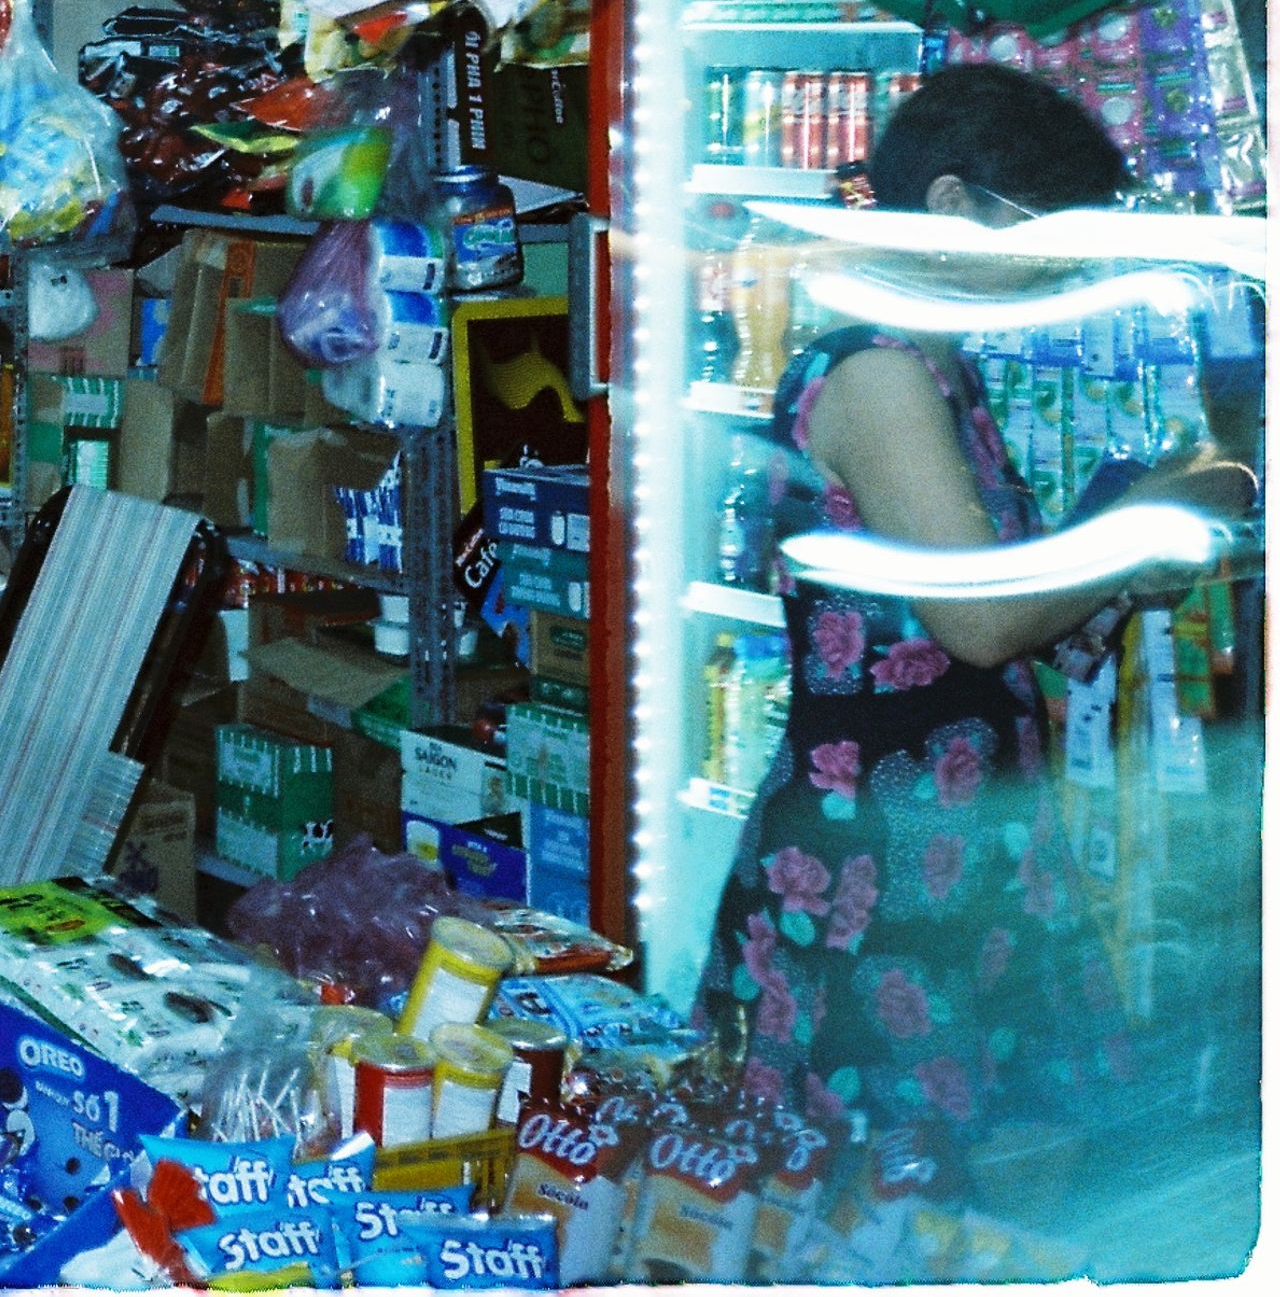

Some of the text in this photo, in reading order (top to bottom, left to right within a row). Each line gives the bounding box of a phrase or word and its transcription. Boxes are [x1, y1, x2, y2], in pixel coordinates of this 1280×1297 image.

[464, 538, 498, 590] Café
[19, 1037, 84, 1077] OREO
[517, 1112, 598, 1166] Otto
[648, 1133, 738, 1182] Otto
[219, 1218, 323, 1273] Staff
[441, 1236, 544, 1282] Staff
